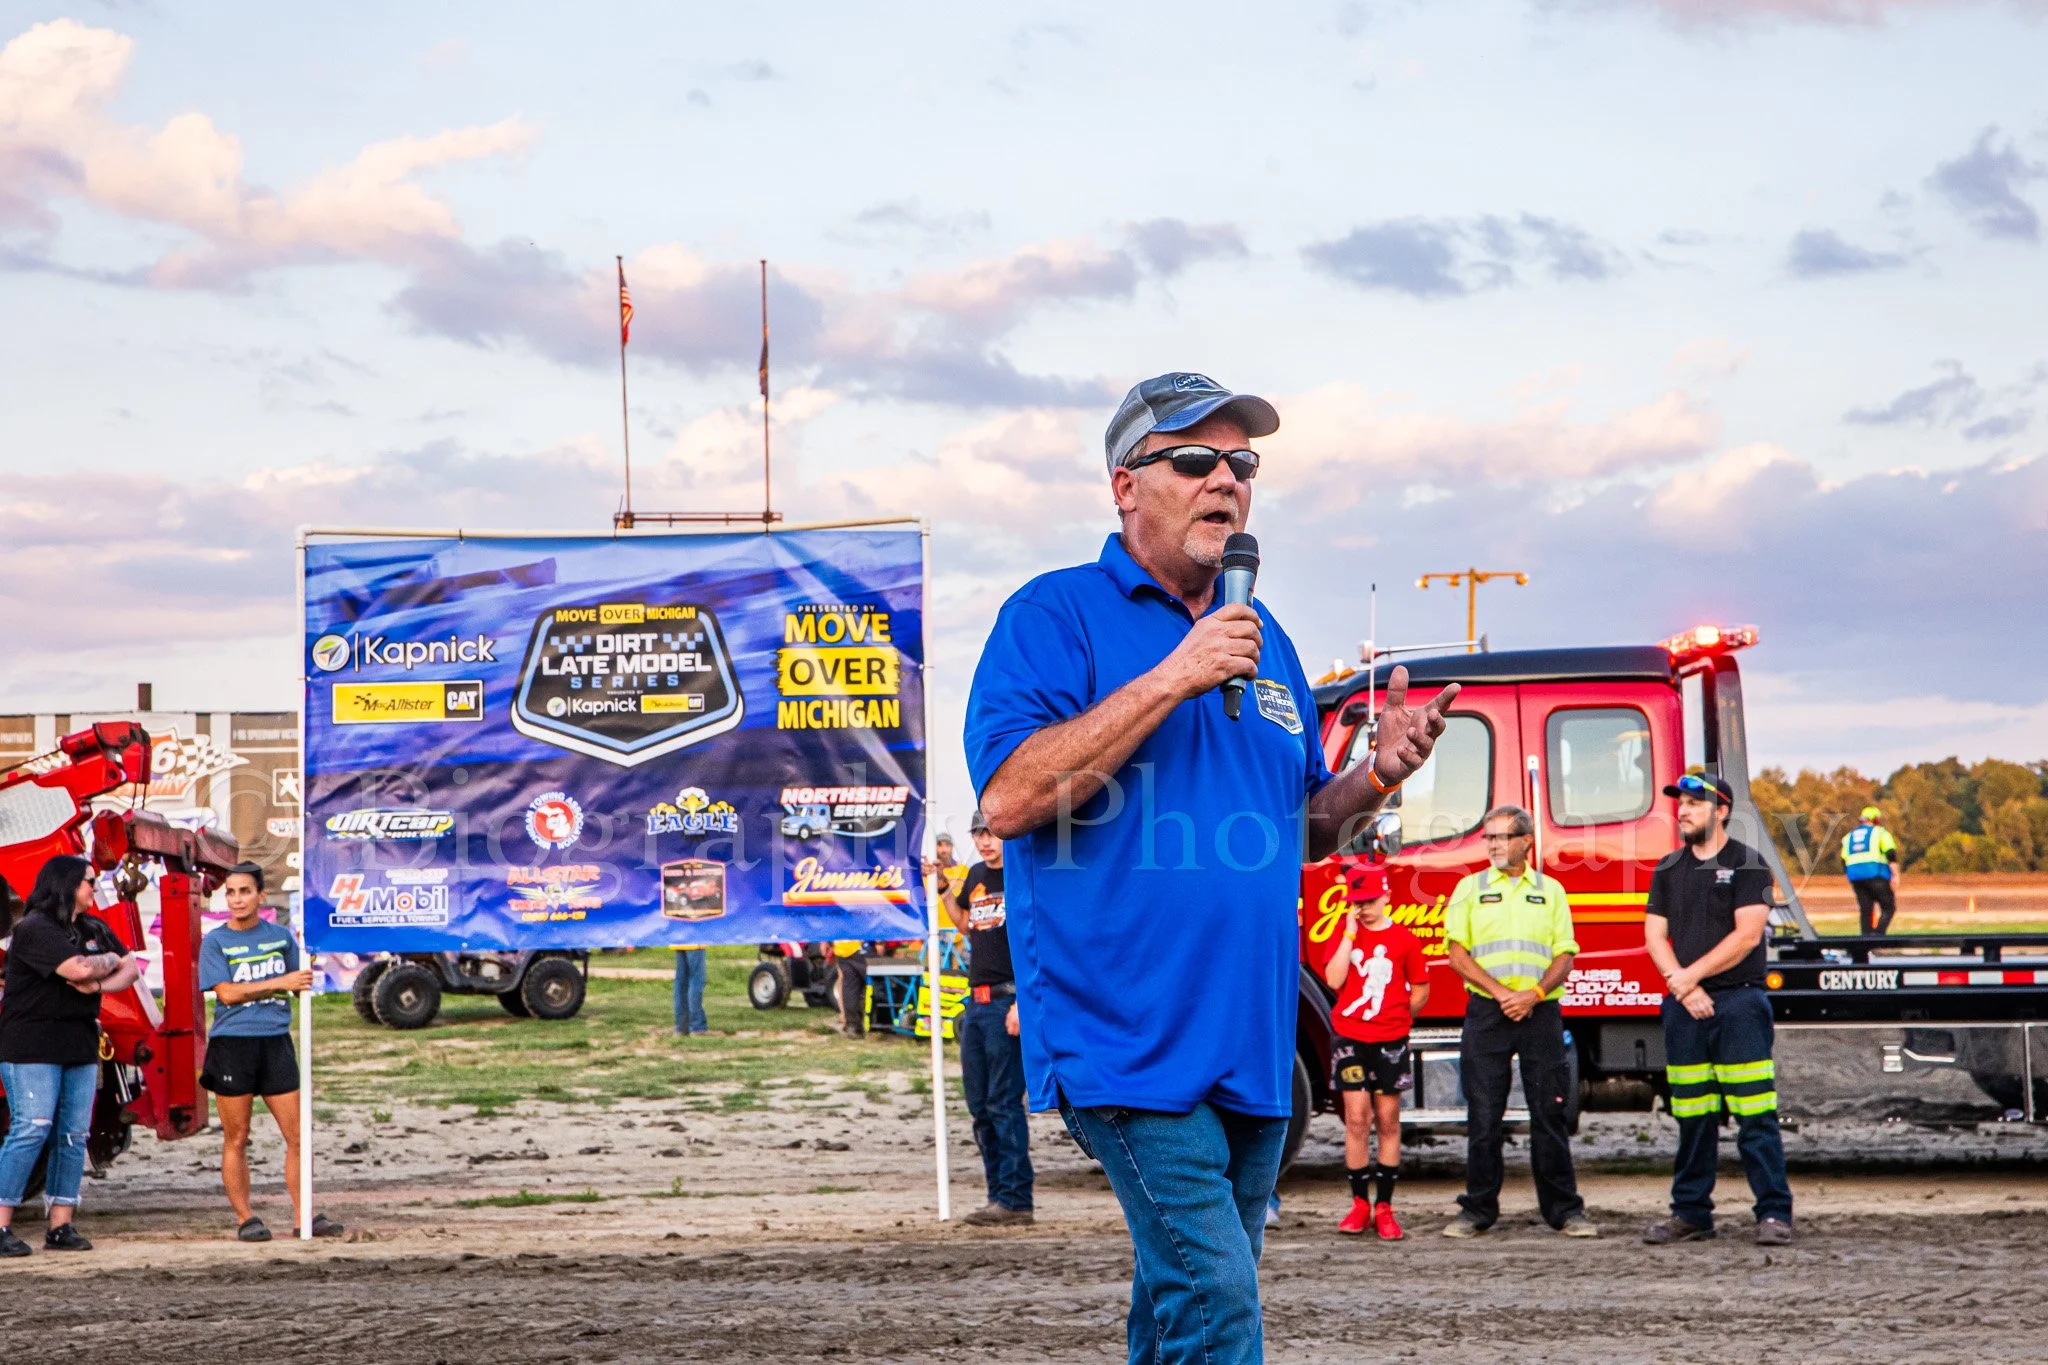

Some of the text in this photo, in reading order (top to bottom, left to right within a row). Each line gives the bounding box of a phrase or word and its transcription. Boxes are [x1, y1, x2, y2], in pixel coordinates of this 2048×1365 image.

[556, 607, 696, 622] MOVE OVER MICHIGAN
[798, 605, 859, 613] PRESENTED
[784, 613, 892, 644] MOVE
[364, 635, 496, 669] Kapnick
[596, 633, 658, 654] DIRT
[542, 653, 712, 676] LATE MODEL
[789, 657, 886, 686] OVER
[571, 676, 680, 689] SERIES
[447, 691, 477, 710] CAT
[572, 696, 637, 715] Kapnick
[778, 699, 900, 730] MICHIGAN
[530, 791, 565, 809] TOWING
[780, 786, 910, 804] NORTHSIDE
[834, 804, 905, 817] SERVICE
[332, 813, 450, 838] DIRTcar
[647, 812, 738, 836] EAGLE
[788, 857, 905, 900] Jimmie's
[372, 887, 447, 912] Mobil
[362, 916, 397, 924] SERVICE
[407, 915, 440, 923] TOWING
[233, 956, 286, 983] Auto
[1819, 970, 1899, 990] CENTURY
